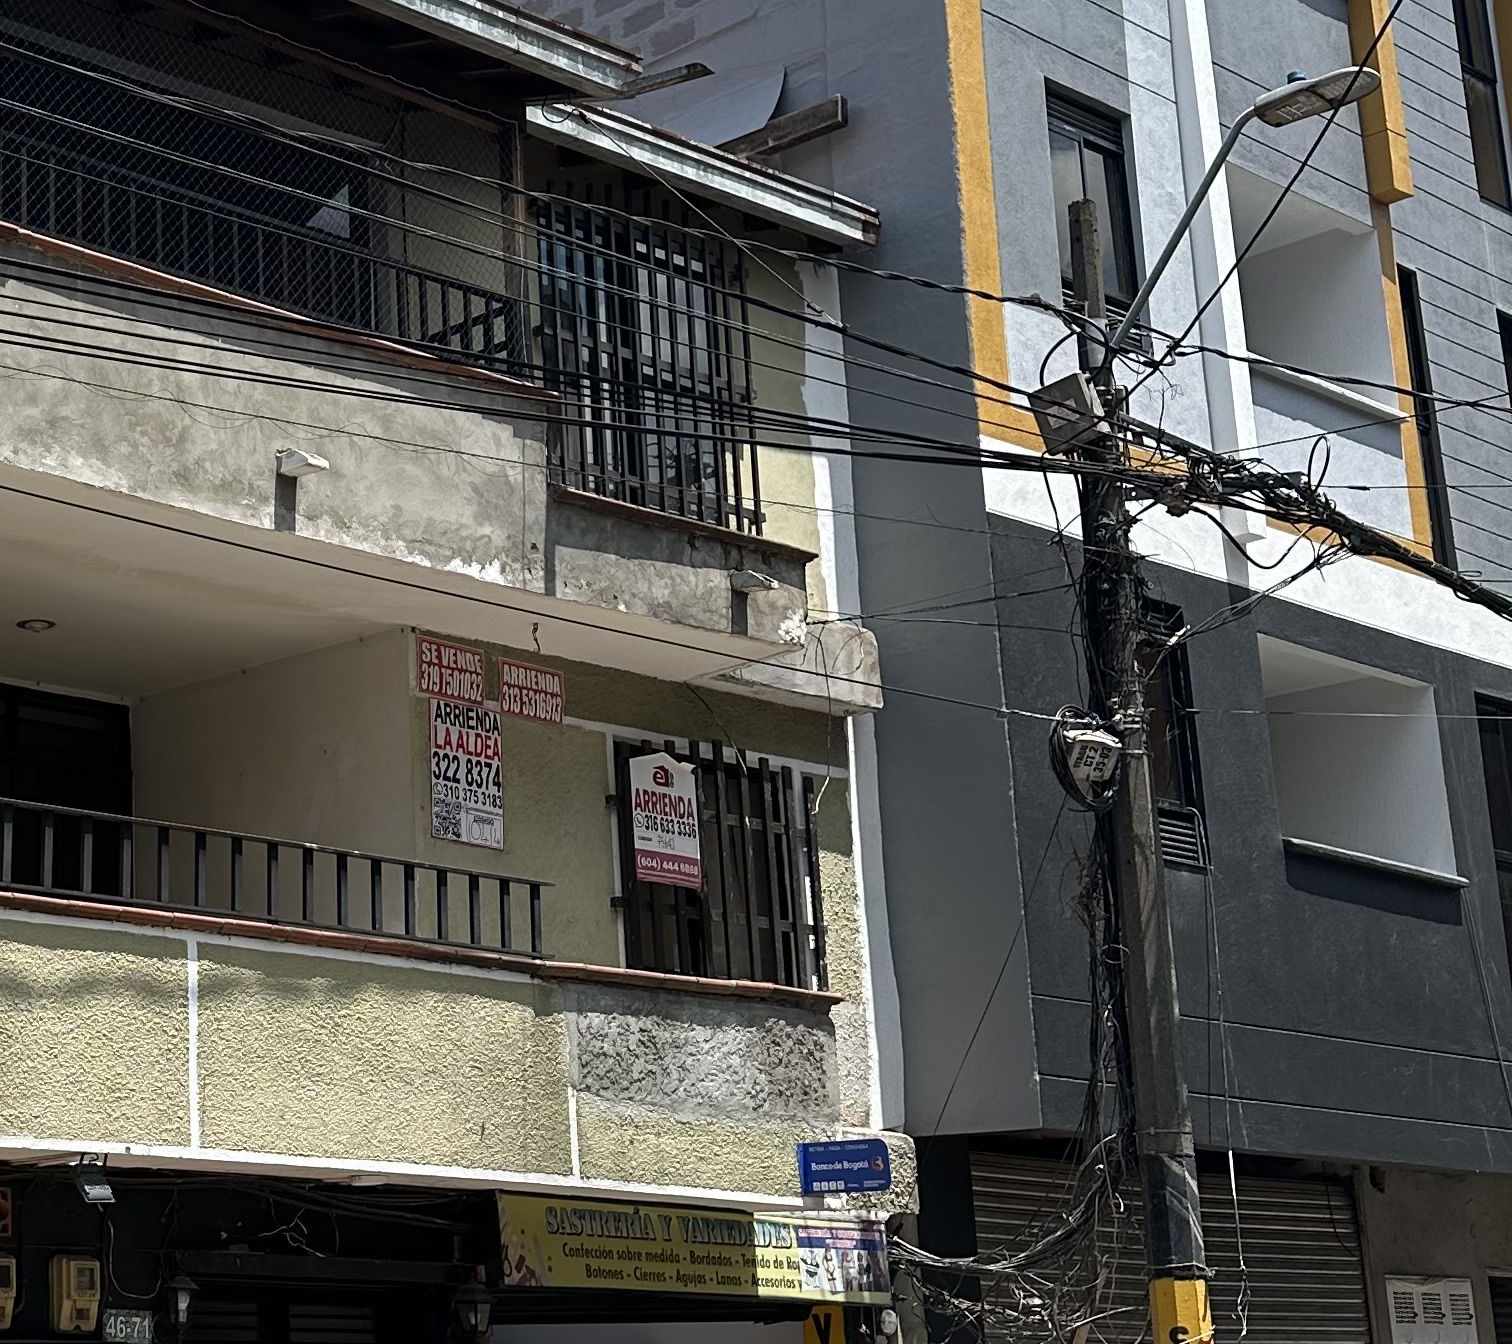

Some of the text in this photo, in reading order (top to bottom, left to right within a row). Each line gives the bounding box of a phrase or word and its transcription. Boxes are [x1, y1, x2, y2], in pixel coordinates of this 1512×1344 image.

[421, 642, 483, 674] SE VENDE
[421, 663, 483, 702] 319 7501032
[502, 663, 561, 695] ARRIENDA
[434, 700, 501, 736] ARRIENDA
[502, 685, 563, 723] 313 5316913
[433, 724, 501, 763] LA ALDEA
[432, 750, 502, 793] 322 8374
[443, 783, 502, 809] 310 375 3183
[634, 787, 696, 822] ARRIENDA
[644, 814, 658, 832] 316
[659, 817, 675, 836] 633
[545, 1206, 657, 1241] SASTRERÍA
[657, 1214, 672, 1242] Y
[676, 1215, 793, 1249] VARIEDADES
[562, 1242, 615, 1260] Confección
[616, 1245, 643, 1262] sobre
[645, 1247, 681, 1264] medida
[689, 1250, 733, 1267] Bordados
[773, 1254, 785, 1270] de
[585, 1263, 625, 1280] Botones
[633, 1266, 667, 1282] Cierres
[675, 1269, 707, 1287] Agujas
[715, 1271, 742, 1286] Lanas
[751, 1273, 796, 1289] Accesorios
[105, 1316, 151, 1340] 46-71
